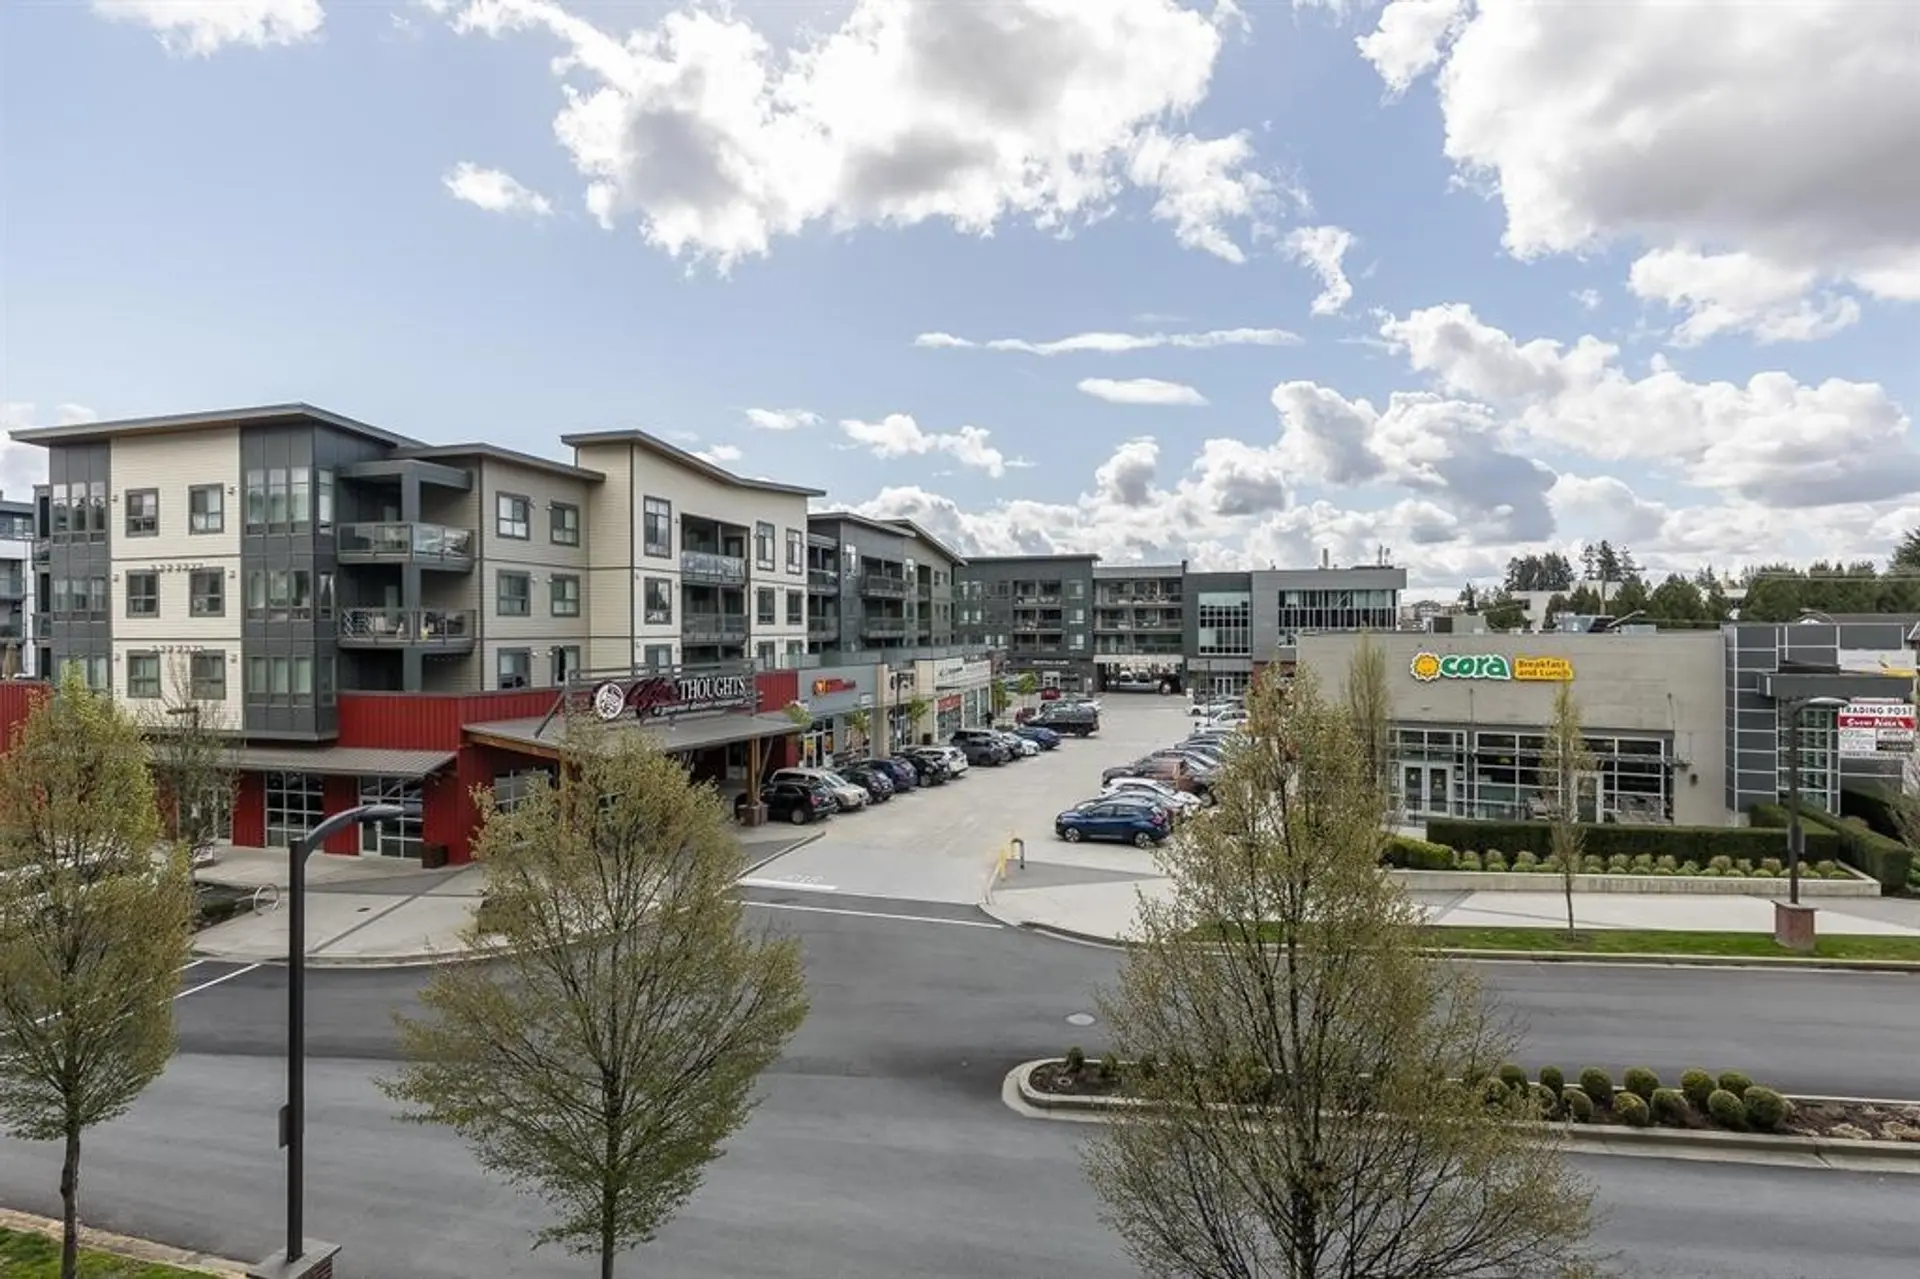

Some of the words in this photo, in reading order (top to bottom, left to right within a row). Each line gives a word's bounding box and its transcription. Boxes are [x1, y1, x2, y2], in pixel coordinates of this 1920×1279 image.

[1441, 654, 1510, 679] cora
[1518, 659, 1566, 669] Breakfast
[1518, 668, 1538, 677] and
[1888, 707, 1912, 715] POST
